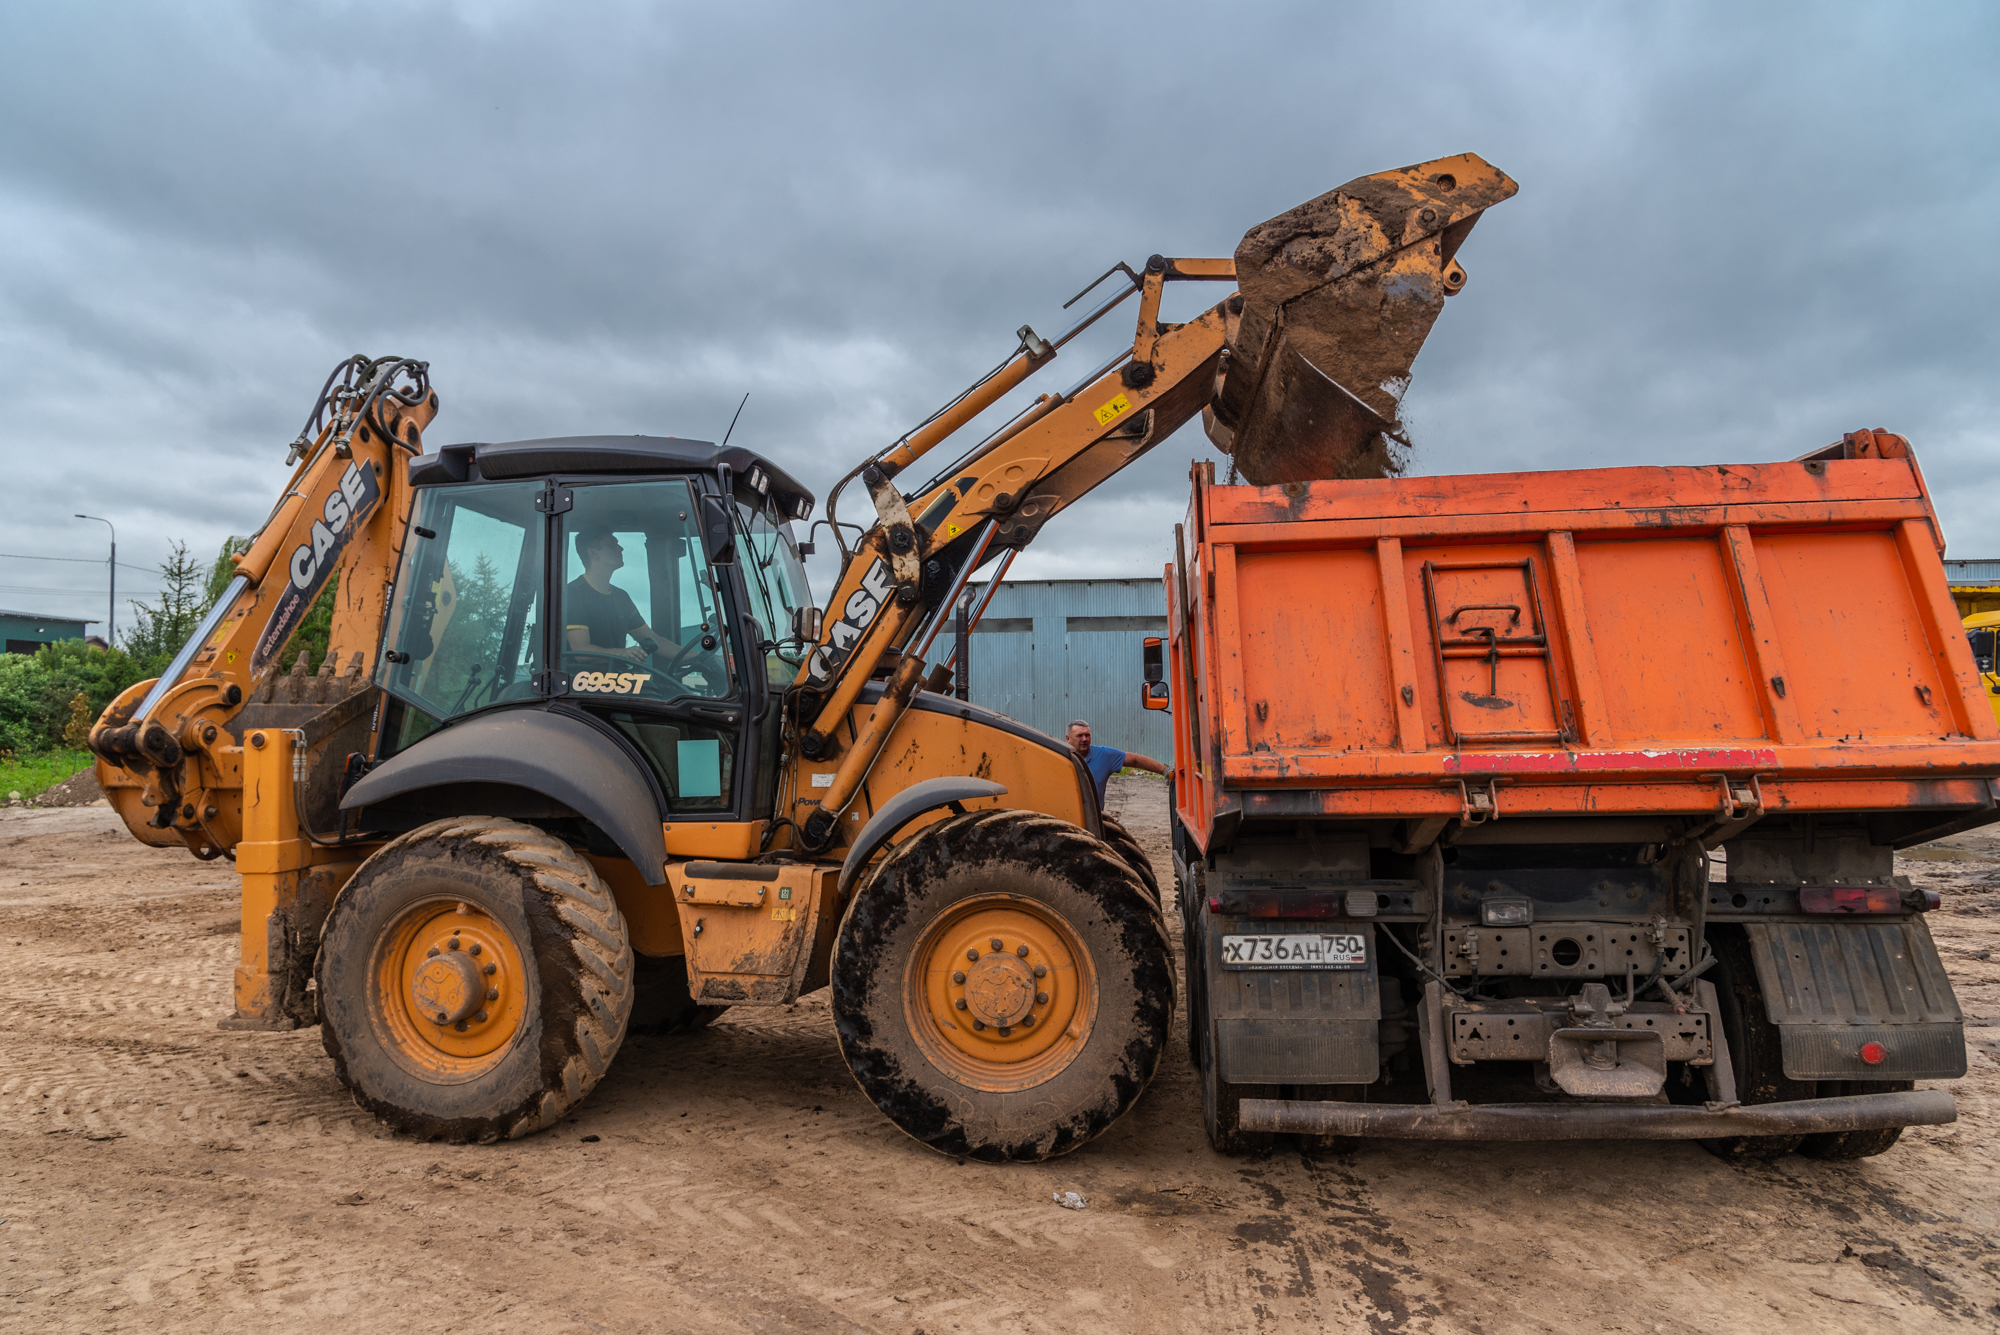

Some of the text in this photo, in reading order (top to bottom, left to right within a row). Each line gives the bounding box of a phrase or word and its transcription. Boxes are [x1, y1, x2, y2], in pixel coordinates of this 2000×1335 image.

[290, 461, 366, 590] CASE
[262, 594, 300, 657] extendahoe
[809, 558, 893, 682] CASE
[572, 671, 651, 694] 695ST
[1324, 936, 1359, 954] 750
